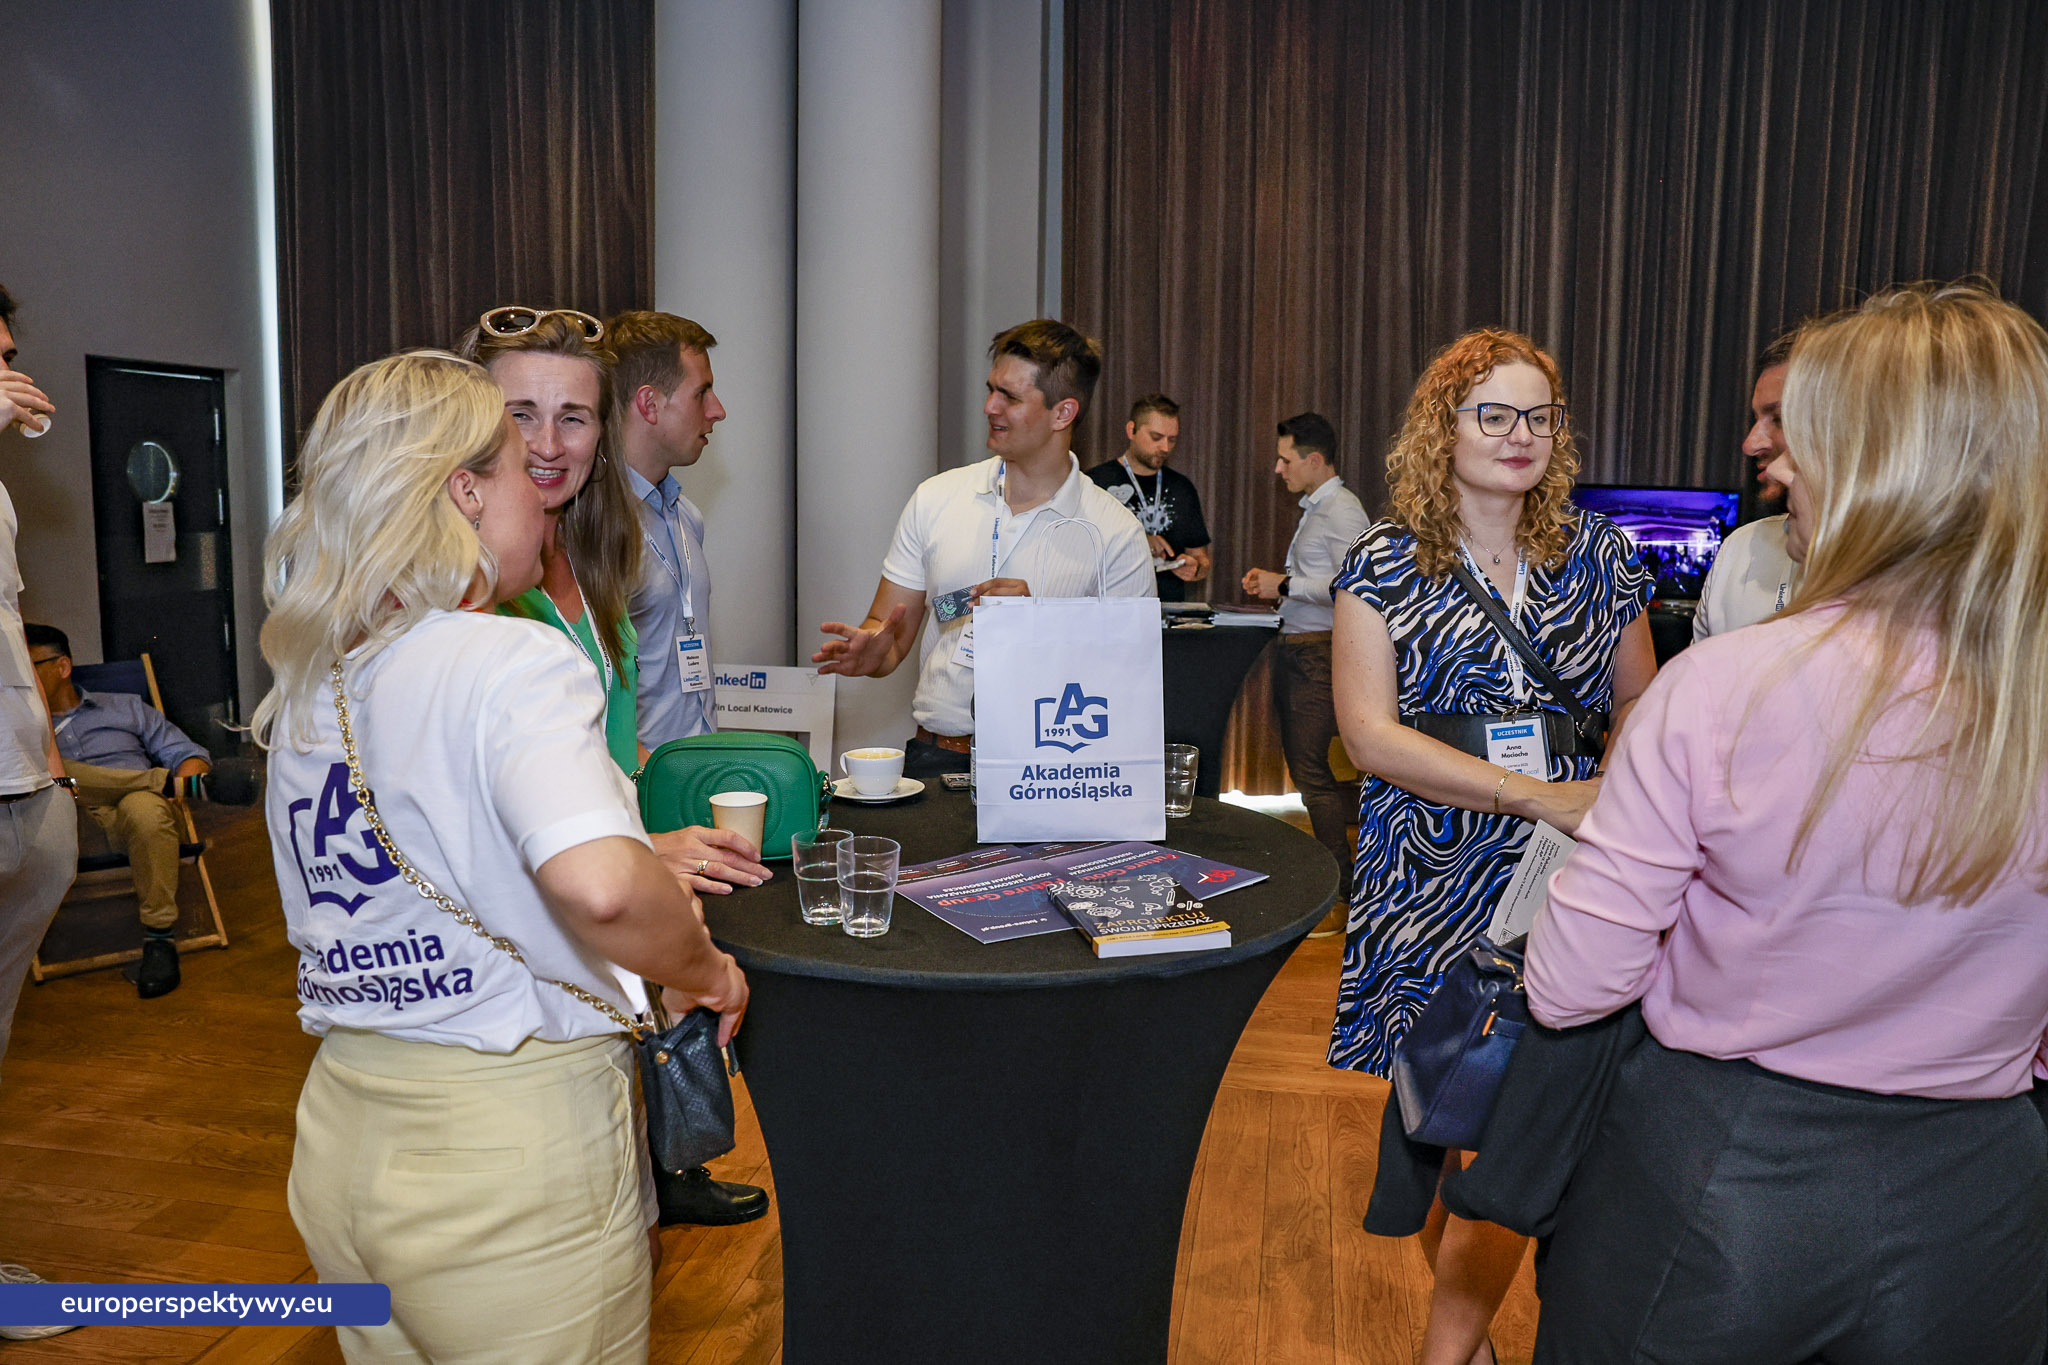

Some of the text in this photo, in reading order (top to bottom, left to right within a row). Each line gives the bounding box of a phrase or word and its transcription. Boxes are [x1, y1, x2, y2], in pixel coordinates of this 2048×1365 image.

[715, 672, 767, 689] nkedin
[727, 704, 752, 713] Local
[753, 705, 793, 714] Katowice
[1044, 728, 1071, 737] 1991
[1497, 728, 1528, 737] UCZESTNIK
[1021, 763, 1120, 781] Akademia
[1009, 780, 1133, 802] Górnośląska
[308, 863, 343, 884] 1991
[942, 872, 1024, 893] HUMAN RESOURCES
[987, 871, 1052, 892] KOMPLEKSOWE
[1079, 867, 1128, 881] Grou
[937, 892, 1002, 907] Group
[1093, 910, 1206, 931] ZAPROJEKTUJ
[1099, 923, 1147, 936] SWOJĄ
[1147, 915, 1214, 932] SPRZEDAŻ
